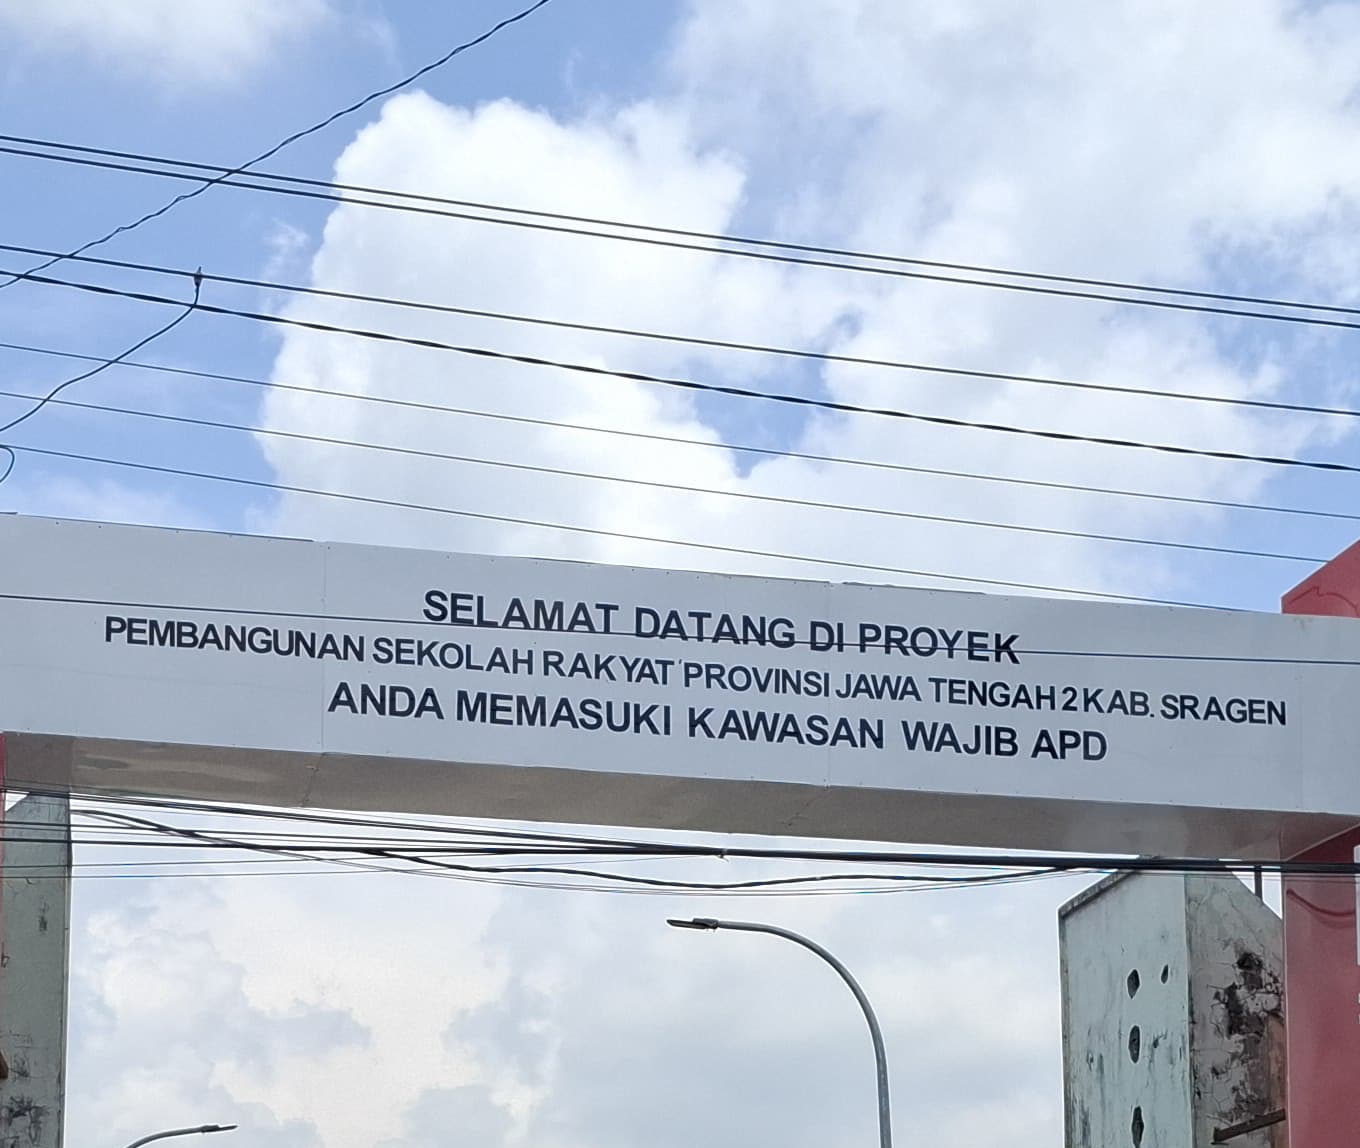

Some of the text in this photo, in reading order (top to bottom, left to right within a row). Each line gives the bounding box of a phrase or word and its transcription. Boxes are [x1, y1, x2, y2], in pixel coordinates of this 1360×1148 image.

[423, 590, 1020, 664] SELAMAT DATANG DI PROYEK
[105, 616, 364, 662] PEMBANGUNAN
[373, 637, 533, 675] SEKOLAH
[543, 651, 674, 686] RAKYAT
[684, 662, 830, 698] PROVINSI
[836, 672, 921, 702] JAWA
[1160, 693, 1288, 726] SRAGEN
[328, 682, 1108, 761] ANDA MEMASUKI KAWASAN WAJIB APD
